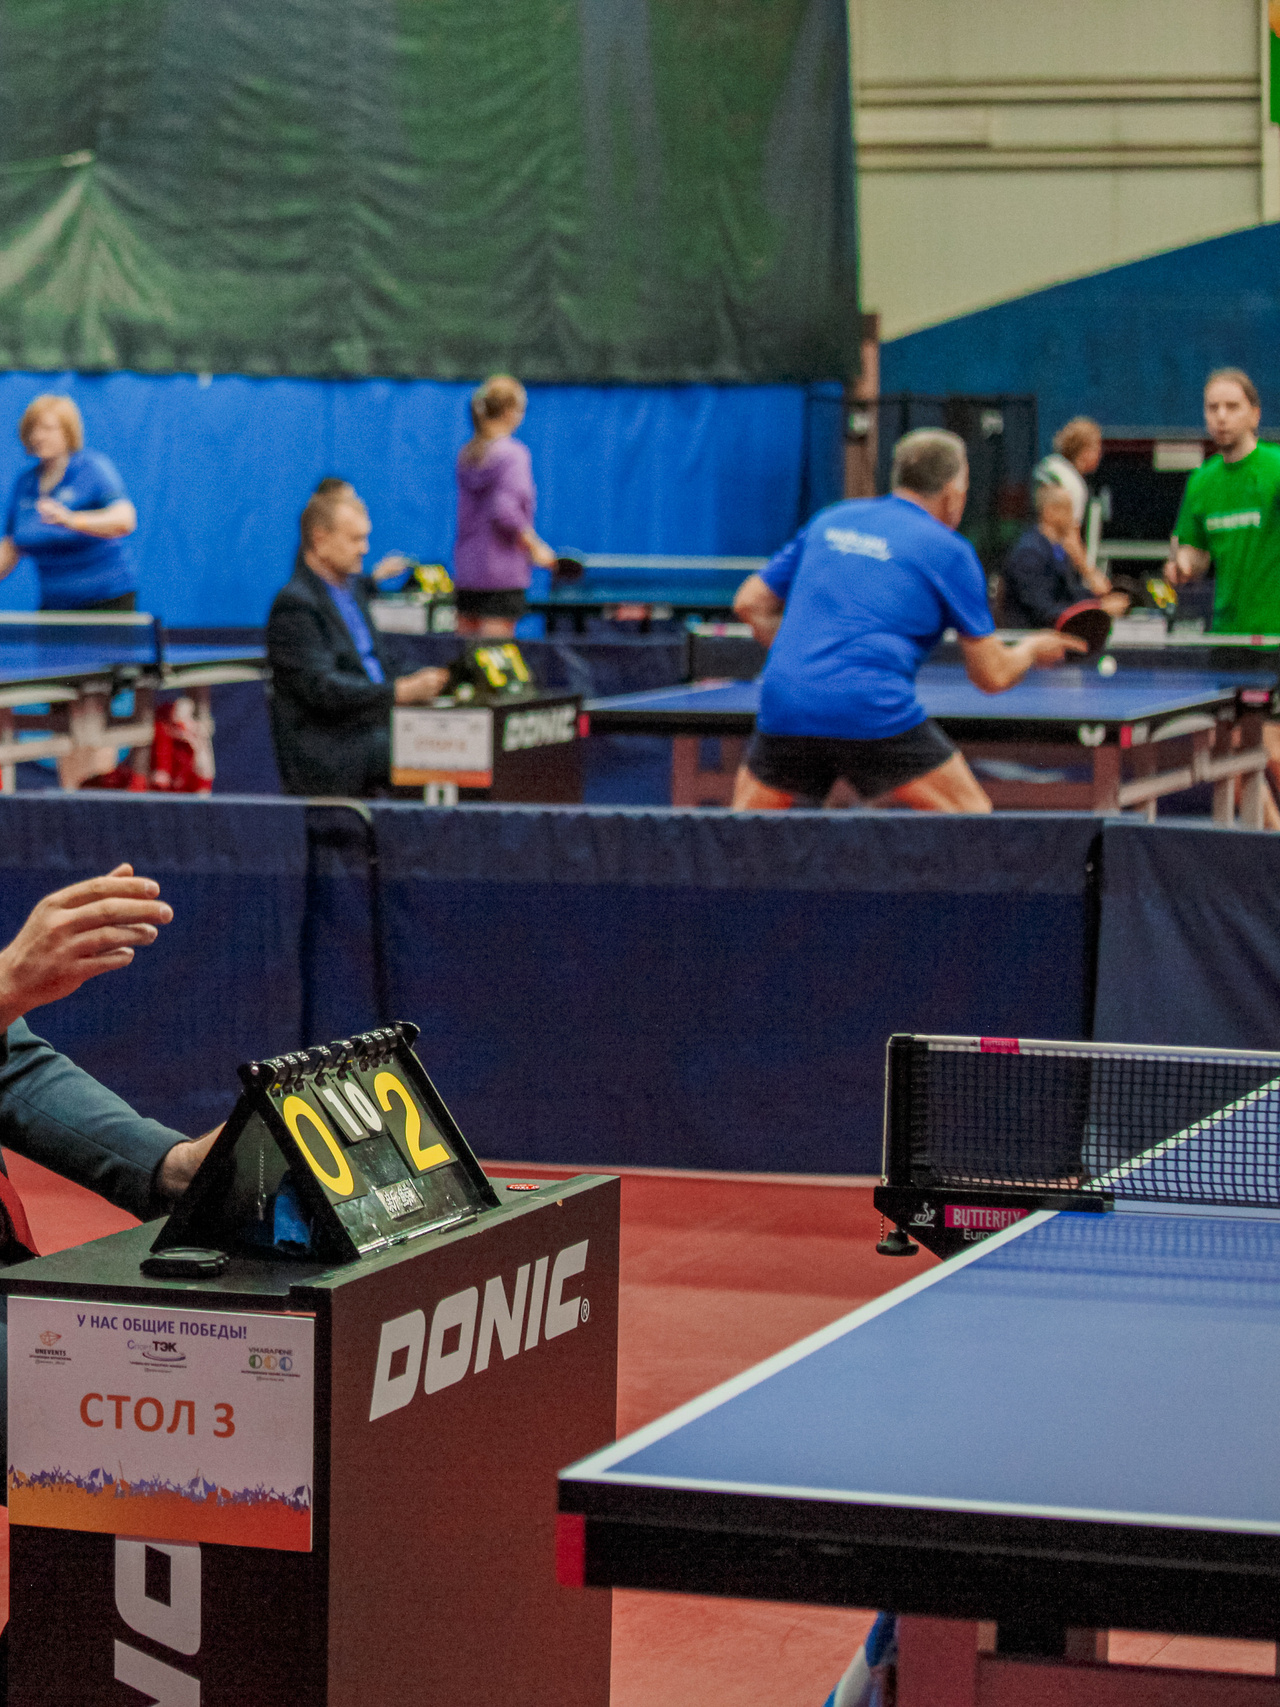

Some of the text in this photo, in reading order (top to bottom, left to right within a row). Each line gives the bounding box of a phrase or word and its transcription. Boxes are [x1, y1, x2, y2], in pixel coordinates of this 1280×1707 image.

[283, 1096, 354, 1196] 0
[374, 1072, 450, 1171] 2
[963, 1228, 997, 1240] Euro
[77, 1314, 247, 1340] У НАС ОБЩИЕ ПОБЕДЫ!
[370, 1239, 589, 1421] DONIC
[35, 1348, 66, 1357] UNEVENTS
[79, 1392, 236, 1439] СТОЛ 3
